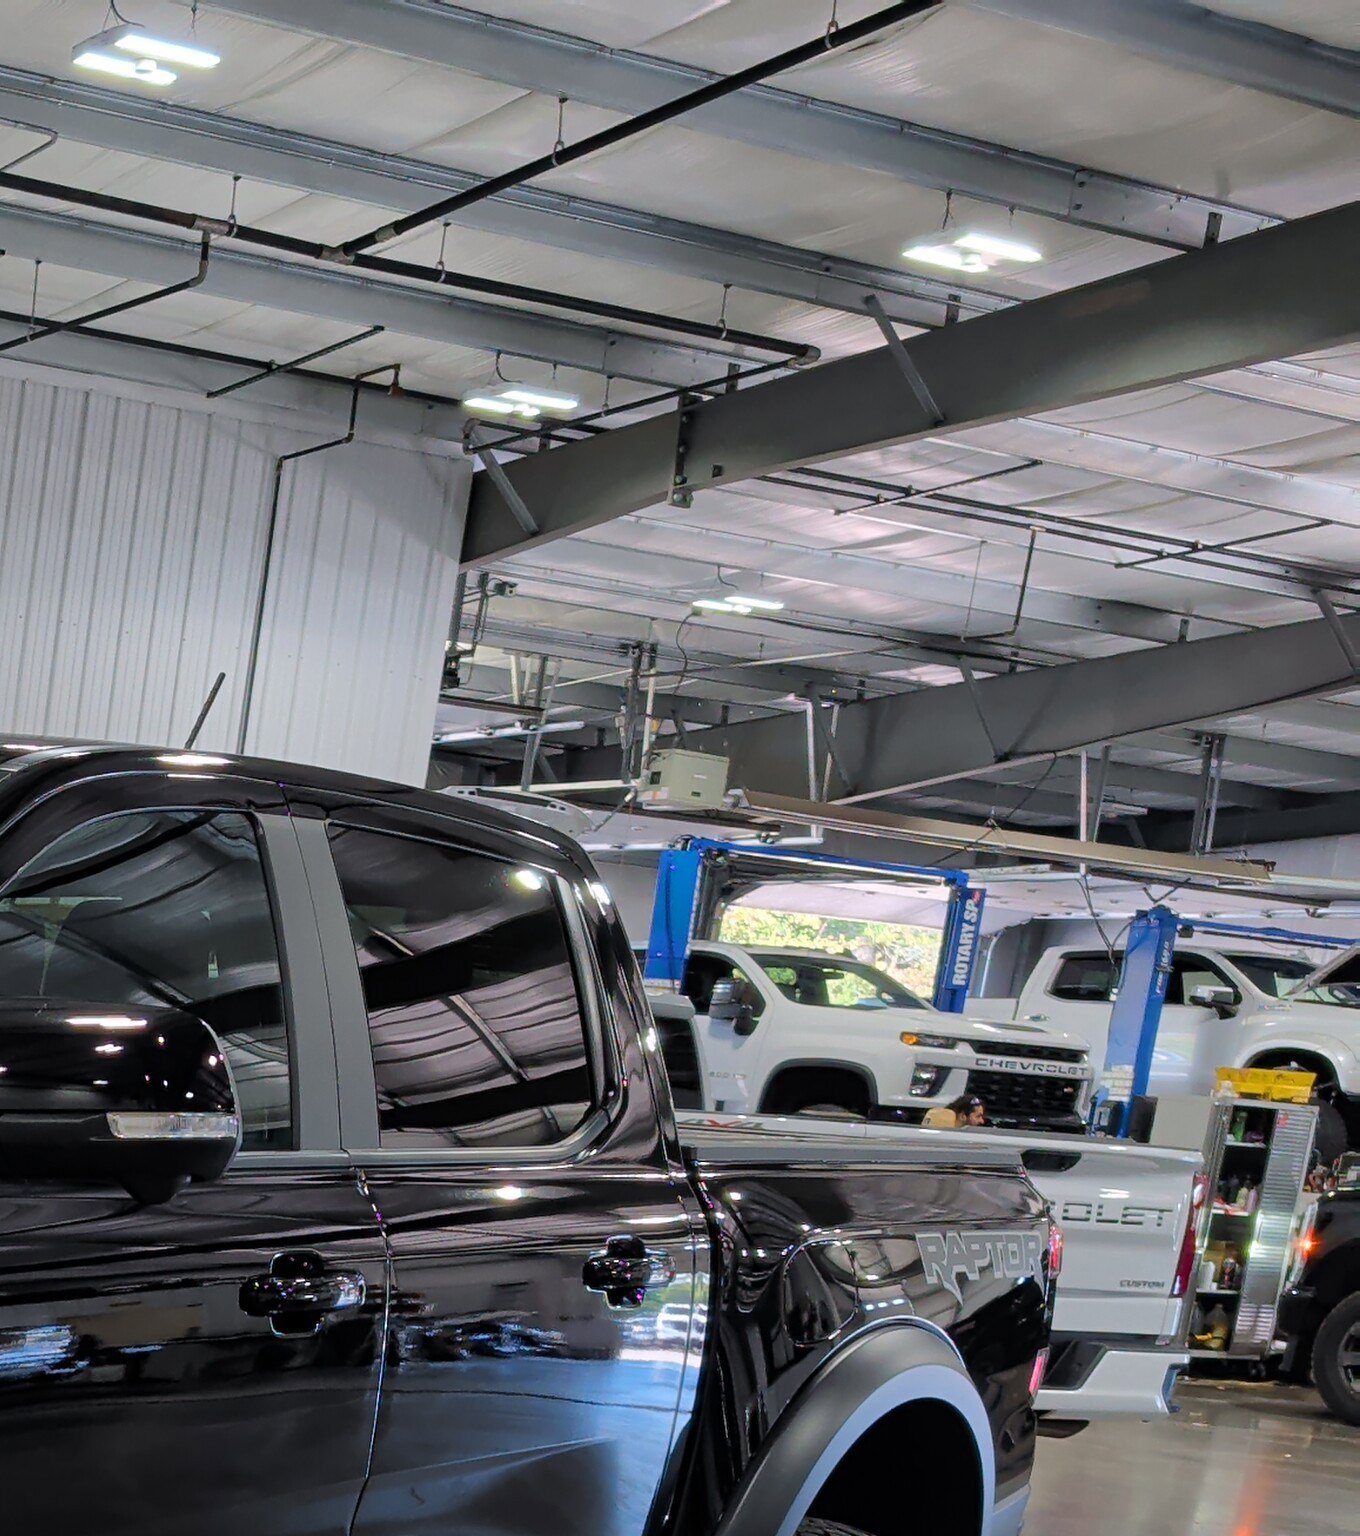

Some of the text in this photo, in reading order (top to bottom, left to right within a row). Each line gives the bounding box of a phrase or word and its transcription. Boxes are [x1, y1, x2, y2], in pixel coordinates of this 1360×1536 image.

[952, 923, 974, 986] ROTARY
[974, 1057, 1089, 1077] CHEVROLET
[915, 1230, 1045, 1308] RAPTOR
[1119, 1279, 1165, 1289] CUSTOM
